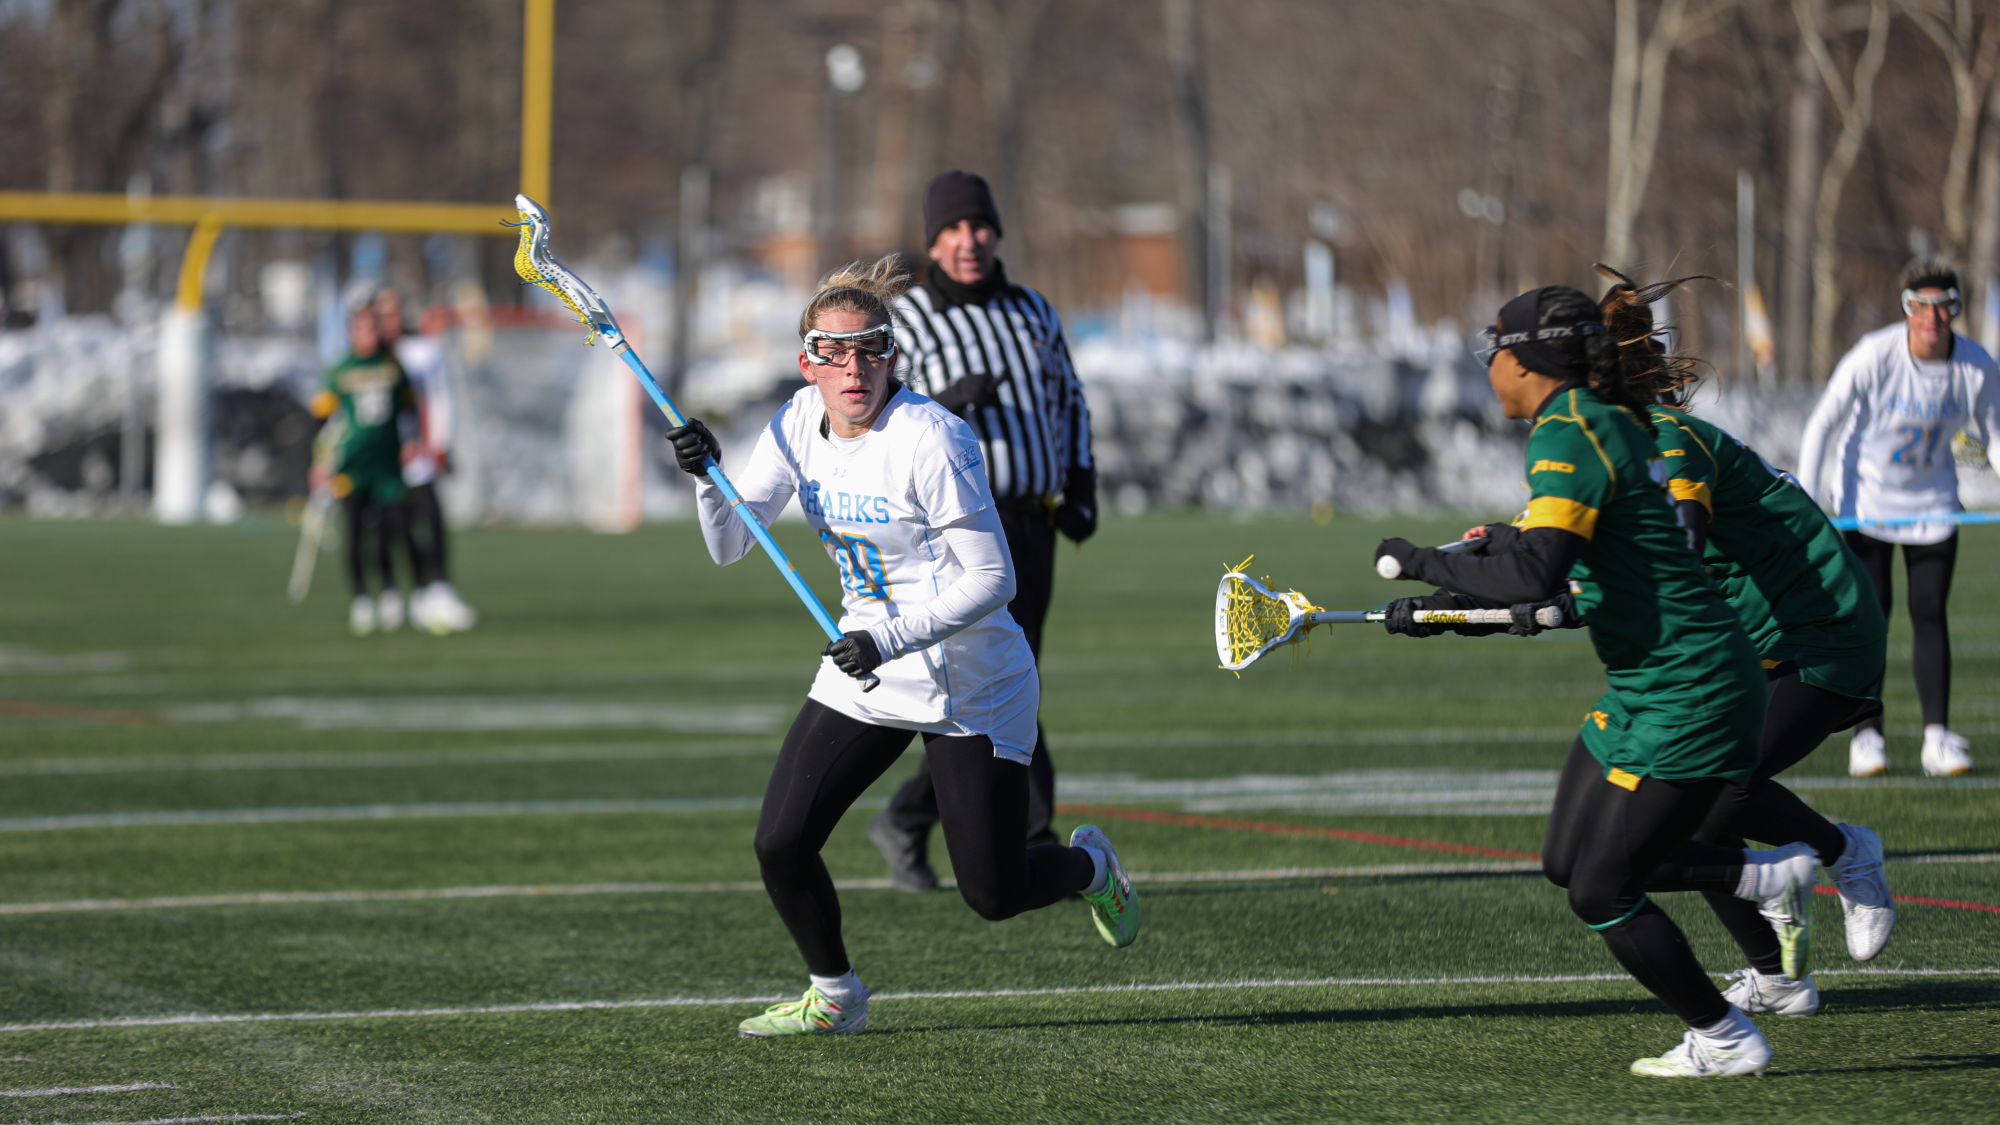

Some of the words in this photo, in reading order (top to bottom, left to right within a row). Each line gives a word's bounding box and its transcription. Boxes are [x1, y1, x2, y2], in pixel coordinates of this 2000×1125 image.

[1500, 332, 1529, 346] STX
[1537, 327, 1573, 340] STX
[661, 403, 684, 428] GAI
[1888, 421, 1946, 470] 21
